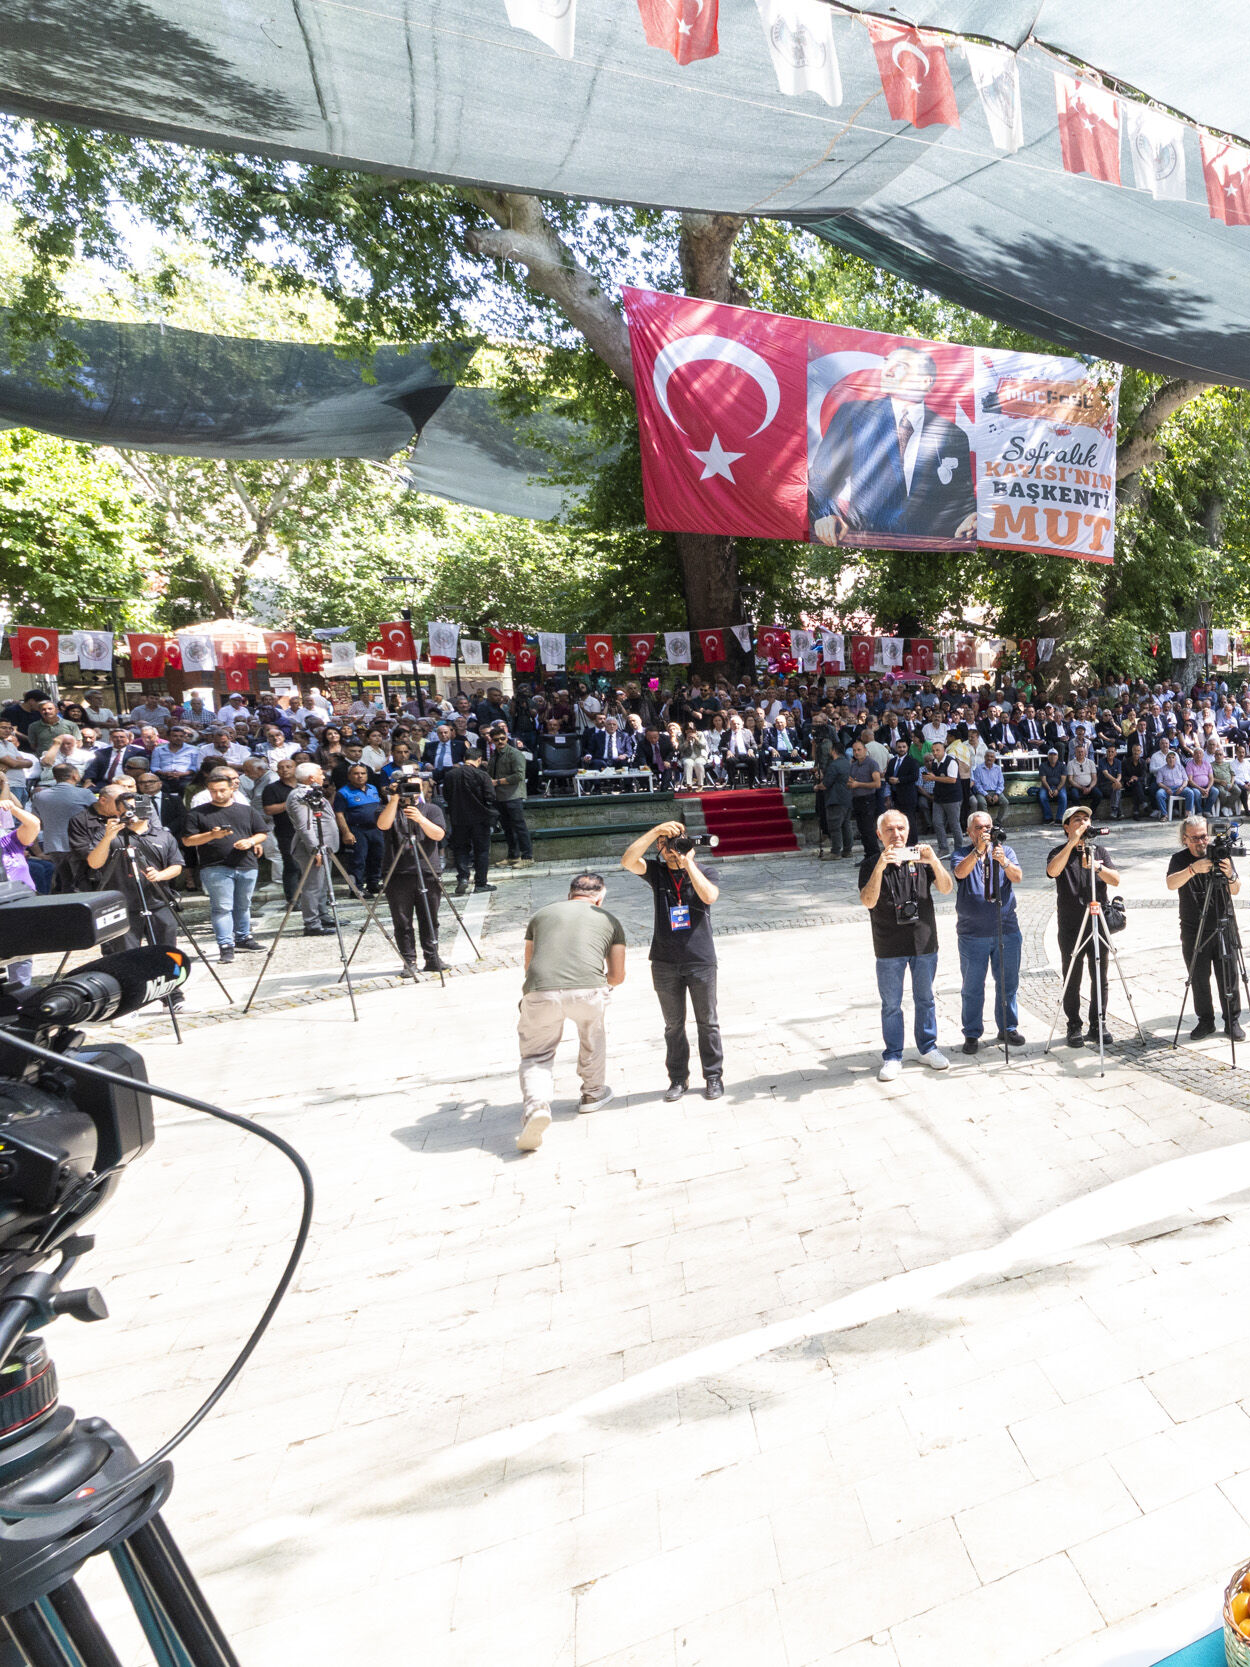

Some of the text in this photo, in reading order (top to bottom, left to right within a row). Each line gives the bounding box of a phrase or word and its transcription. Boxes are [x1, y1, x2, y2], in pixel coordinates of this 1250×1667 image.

[1002, 435, 1098, 475] Sofralık
[984, 461, 1112, 491] KAYISI'NIN
[992, 481, 1110, 511] BAŞKENTİ
[989, 503, 1112, 552] MUT
